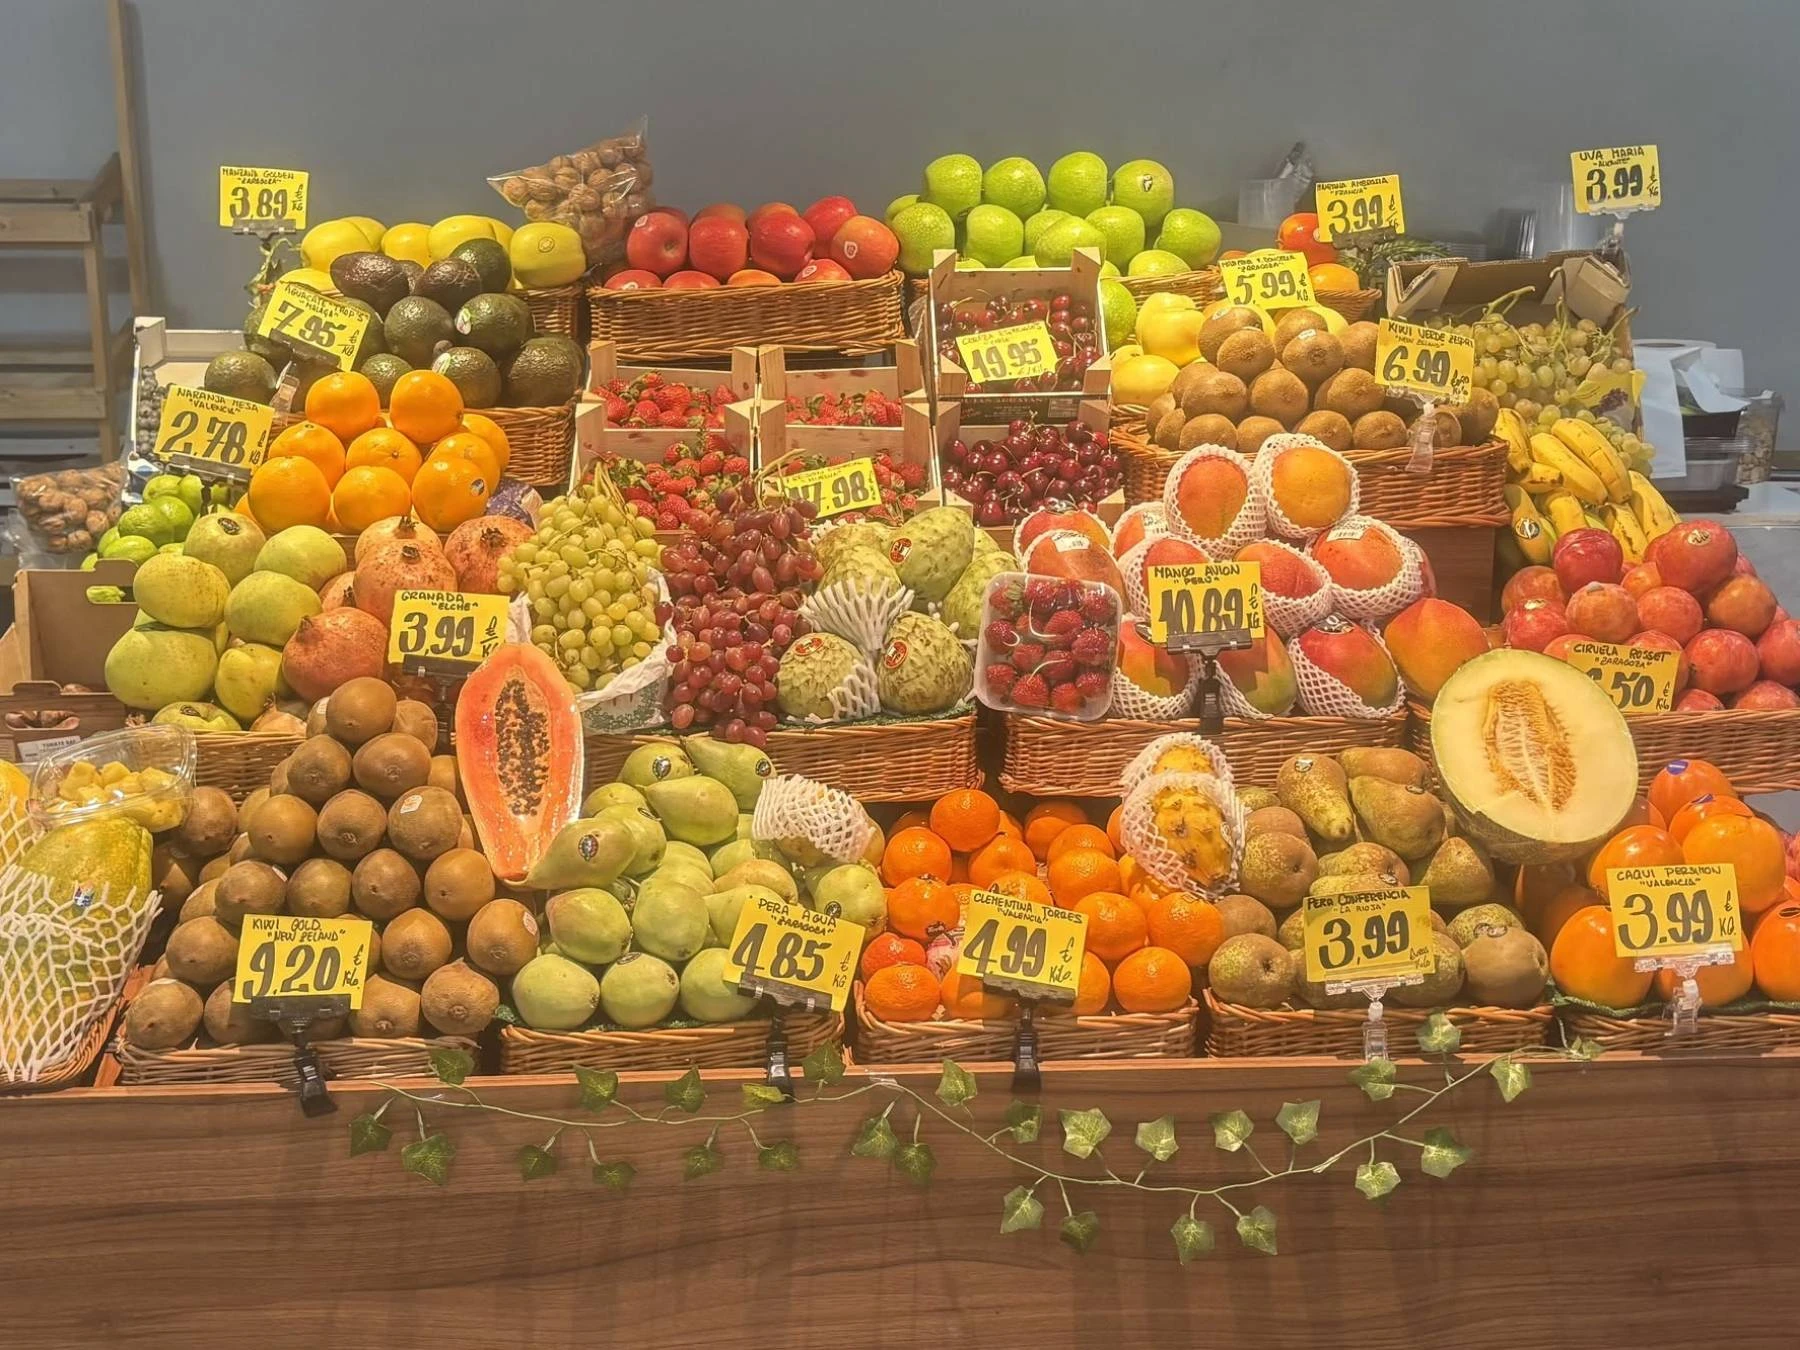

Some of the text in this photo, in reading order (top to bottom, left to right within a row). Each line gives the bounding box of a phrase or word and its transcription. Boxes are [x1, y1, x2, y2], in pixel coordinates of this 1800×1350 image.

[1580, 147, 1645, 161] UVA MARIA
[285, 285, 327, 309] AGUACATE
[1388, 321, 1412, 336] KIWI
[1418, 328, 1445, 342] VERDE
[177, 387, 259, 413] NARANJA MESA
[1154, 564, 1240, 578] MANGO AVION
[401, 591, 465, 603] GRANADA
[1573, 643, 1672, 662] CIRUELA ROSSET
[1617, 866, 1721, 881] CAQUI PERSIMON
[973, 892, 1083, 924] CLEMENTINA TORRES
[1307, 889, 1411, 911] PERA CONFERENCIA
[758, 898, 837, 928] PERA AGUA
[252, 918, 279, 930] KIWI
